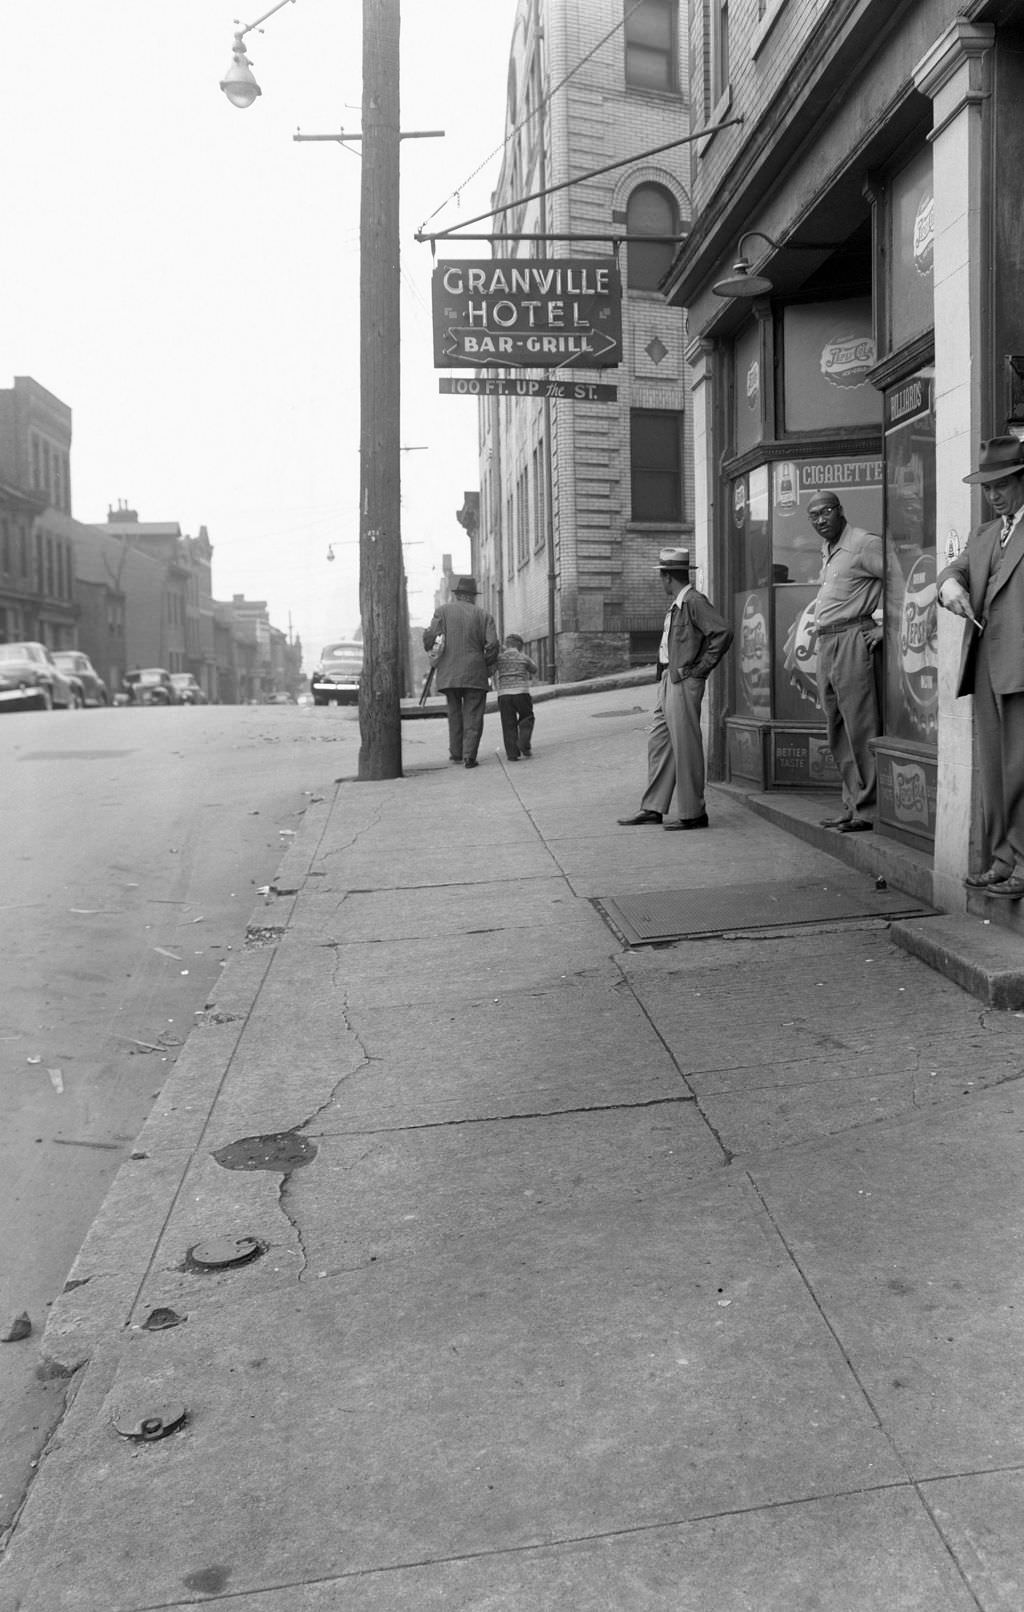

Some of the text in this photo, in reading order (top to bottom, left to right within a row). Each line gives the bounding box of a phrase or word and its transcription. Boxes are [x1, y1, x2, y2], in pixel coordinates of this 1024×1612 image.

[443, 268, 609, 295] GRANVILLE
[468, 300, 590, 327] HOTEL
[464, 336, 594, 353] BAR-GRILL
[451, 379, 598, 399] 100 FT. UP the ST.
[891, 382, 922, 422] BILLIARDS
[776, 747, 807, 757] BETTER
[780, 758, 805, 768] TASTE
